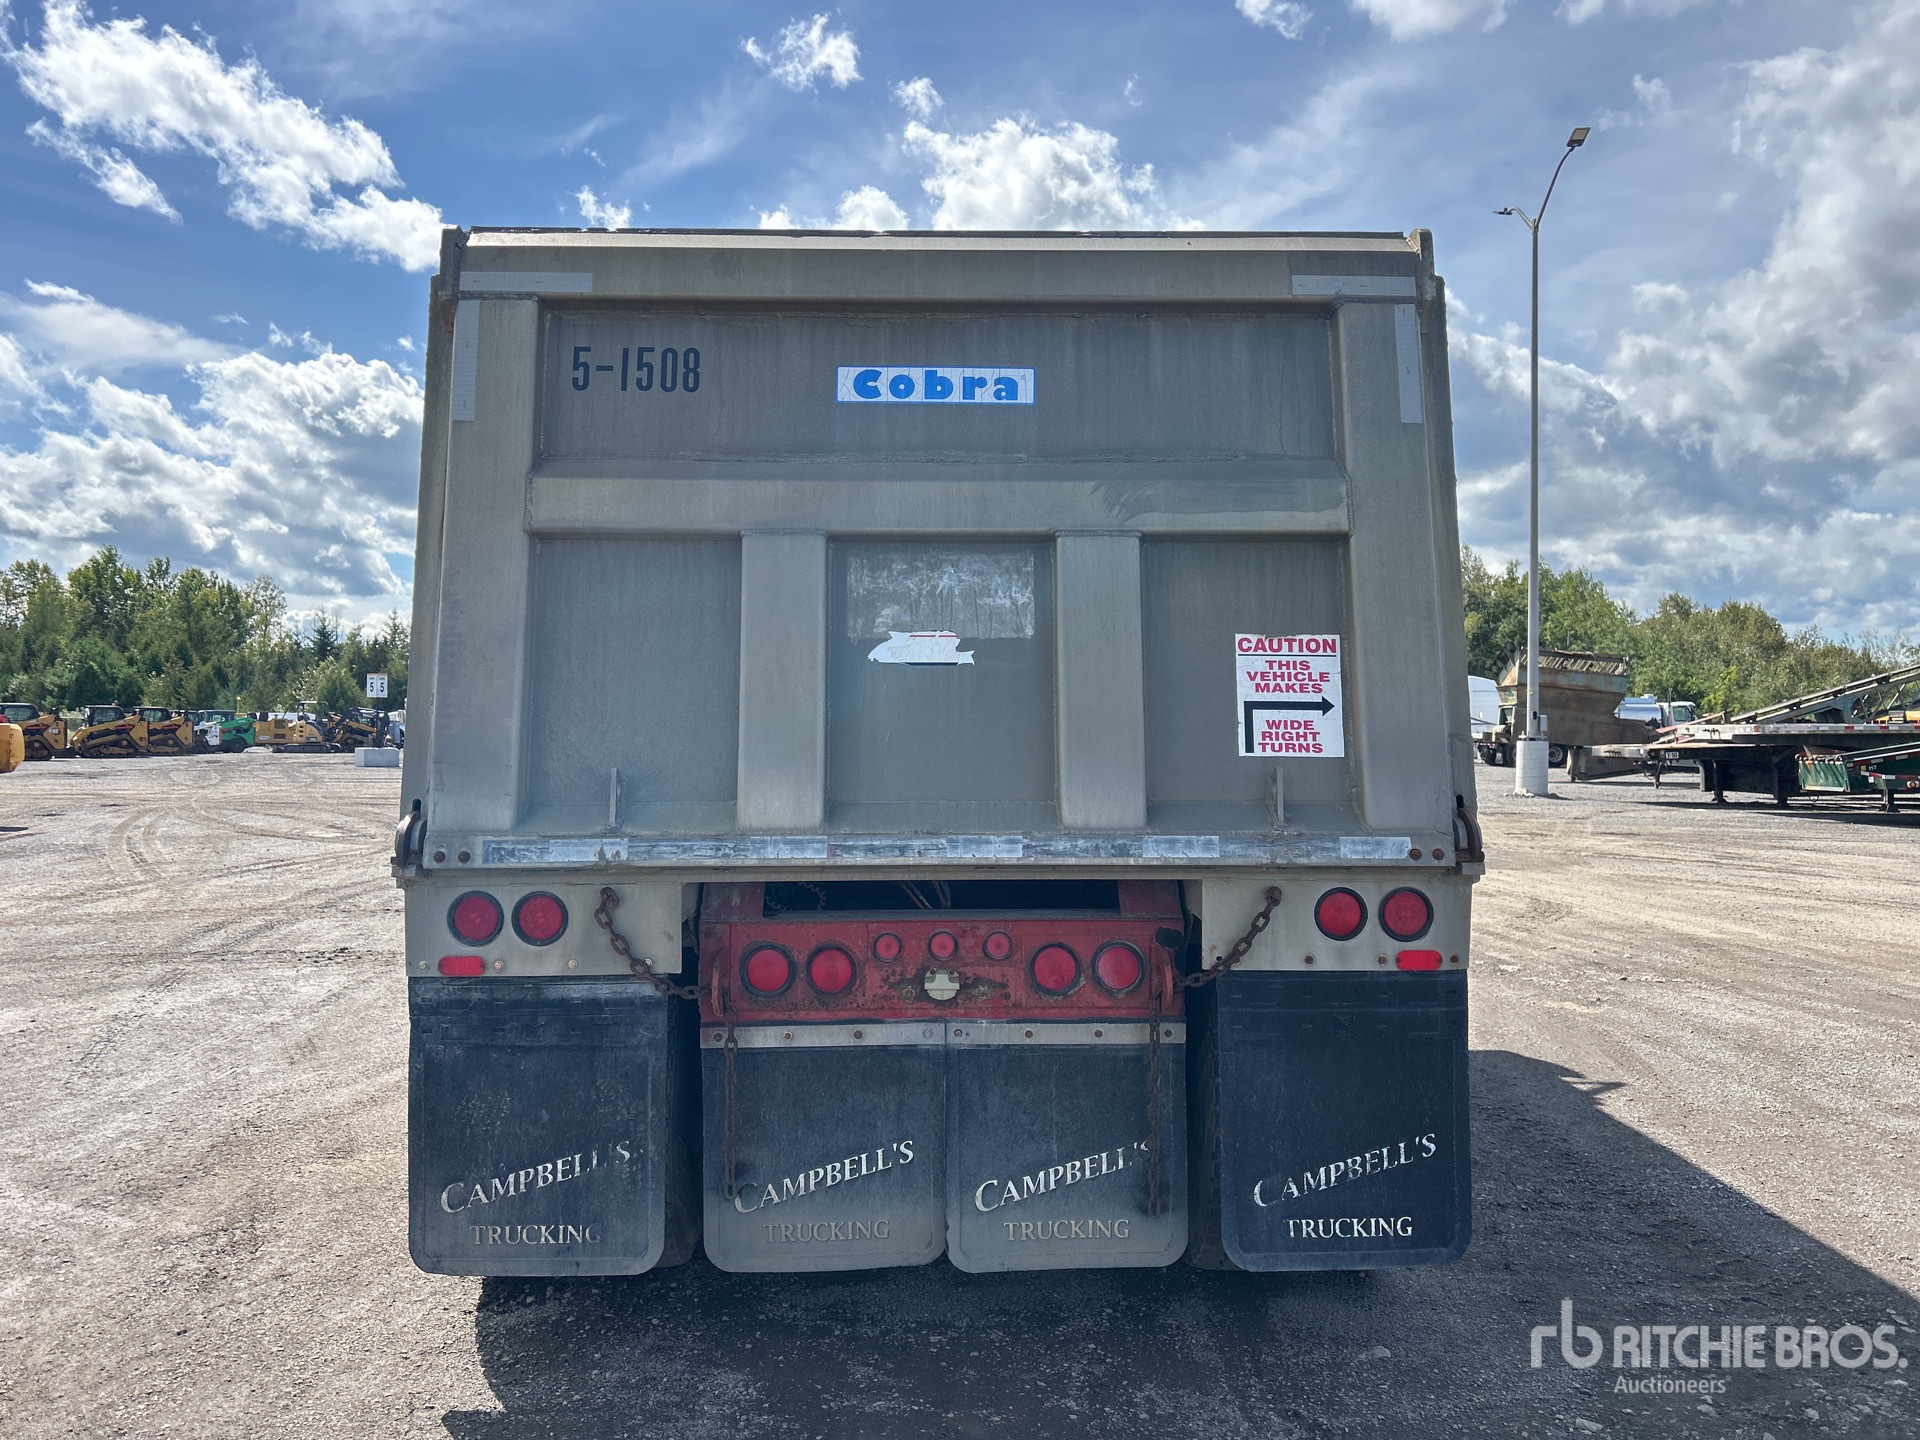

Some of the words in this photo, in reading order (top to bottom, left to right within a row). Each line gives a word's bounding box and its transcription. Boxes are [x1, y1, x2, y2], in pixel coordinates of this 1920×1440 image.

[572, 346, 700, 393] 5-1508
[853, 369, 1019, 401] Cobra
[1237, 637, 1337, 653] CAUTION
[1265, 660, 1311, 671] THIS
[1246, 671, 1331, 682] VEHICLE
[369, 681, 375, 693] 5
[379, 682, 385, 693] 5
[1255, 683, 1324, 694] MAKES
[1265, 720, 1315, 731] WIDE
[1261, 731, 1321, 742] RIGHT
[1258, 742, 1324, 753] TURNS
[735, 1140, 914, 1214] CAMPBELL'S
[1253, 1133, 1437, 1207] CAMPBELL'S
[763, 1220, 890, 1243] TRUCKING
[1003, 1219, 1130, 1241] TRUCKING
[1284, 1216, 1413, 1239] TRUCKING
